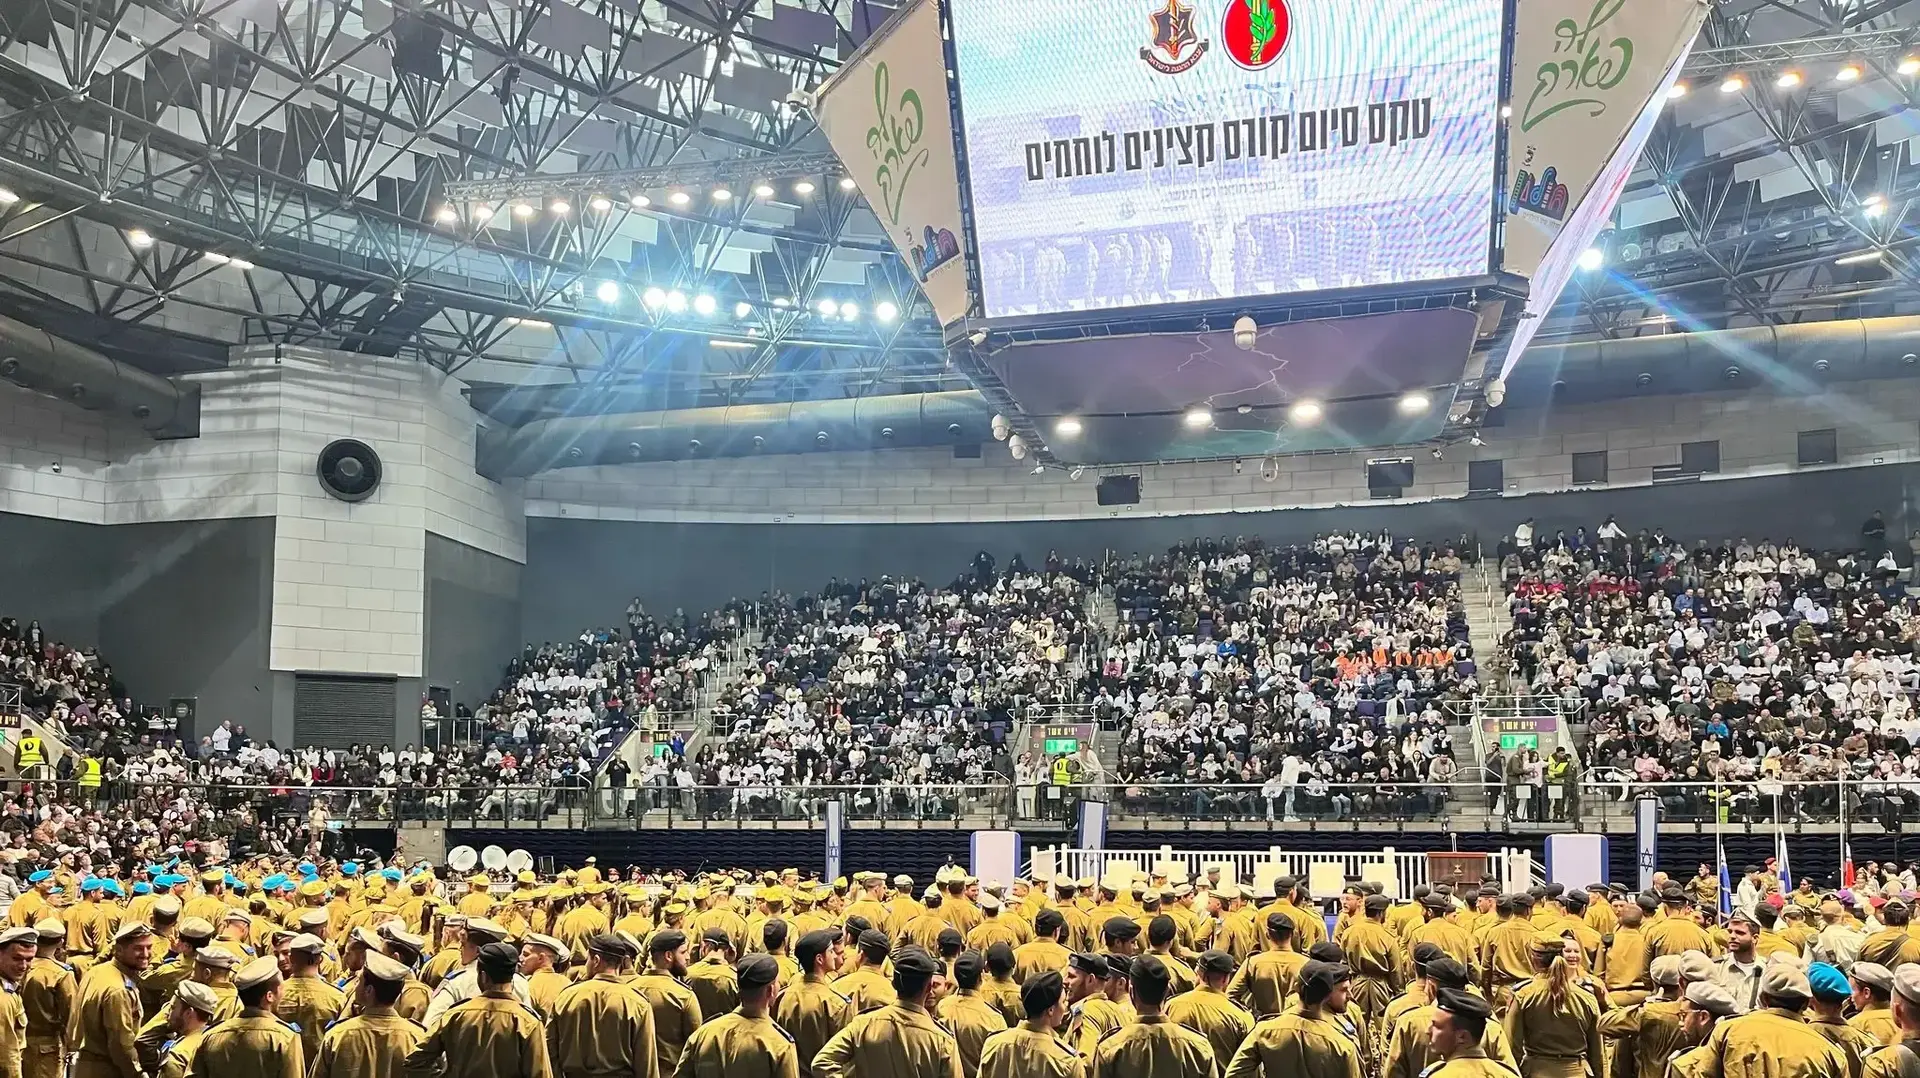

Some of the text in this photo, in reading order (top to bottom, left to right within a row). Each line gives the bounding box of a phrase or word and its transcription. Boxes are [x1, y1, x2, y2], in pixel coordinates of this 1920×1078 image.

[1025, 97, 1432, 181] טקס סיום קורס קצינים לוחמים
